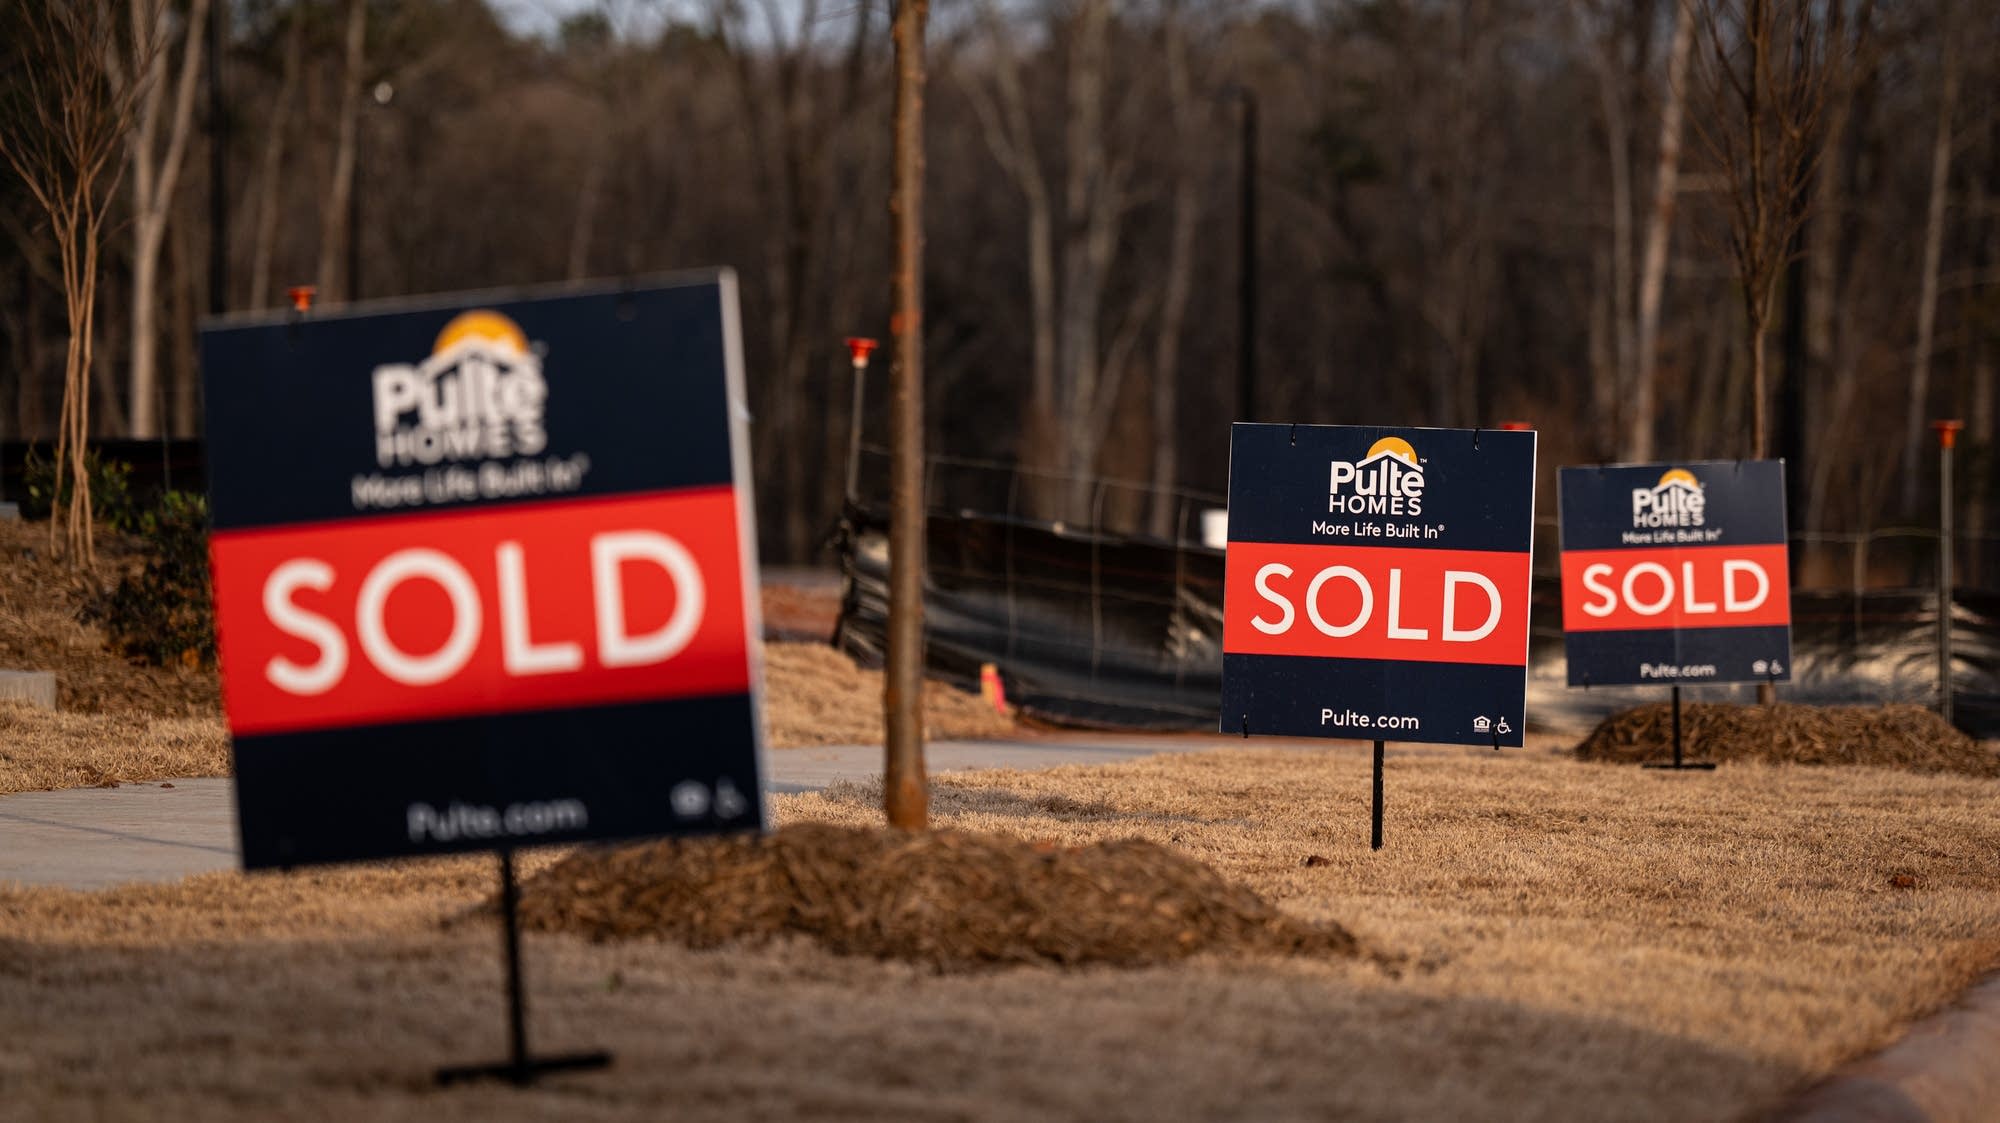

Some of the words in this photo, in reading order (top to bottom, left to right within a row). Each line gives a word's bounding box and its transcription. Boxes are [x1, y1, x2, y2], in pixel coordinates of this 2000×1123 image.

[372, 357, 548, 432] Pulte
[377, 424, 547, 467] HOMES
[1330, 459, 1425, 497] Pulte
[1329, 495, 1422, 516] HOMES
[1632, 486, 1706, 515] Pulte
[1312, 521, 1350, 535] More
[1354, 522, 1381, 536] Life
[1386, 523, 1420, 538] Built
[1622, 532, 1652, 544] More
[1653, 529, 1675, 543] Life
[1676, 529, 1704, 542] Built
[1633, 512, 1705, 528] HOMES
[1250, 562, 1502, 642] SOLD
[1582, 559, 1769, 617] SOLD
[263, 529, 706, 695] SOLD
[1640, 663, 1716, 678] Pulte.com
[1321, 708, 1419, 729] Pulte.com
[407, 801, 588, 842] Pulte.com
